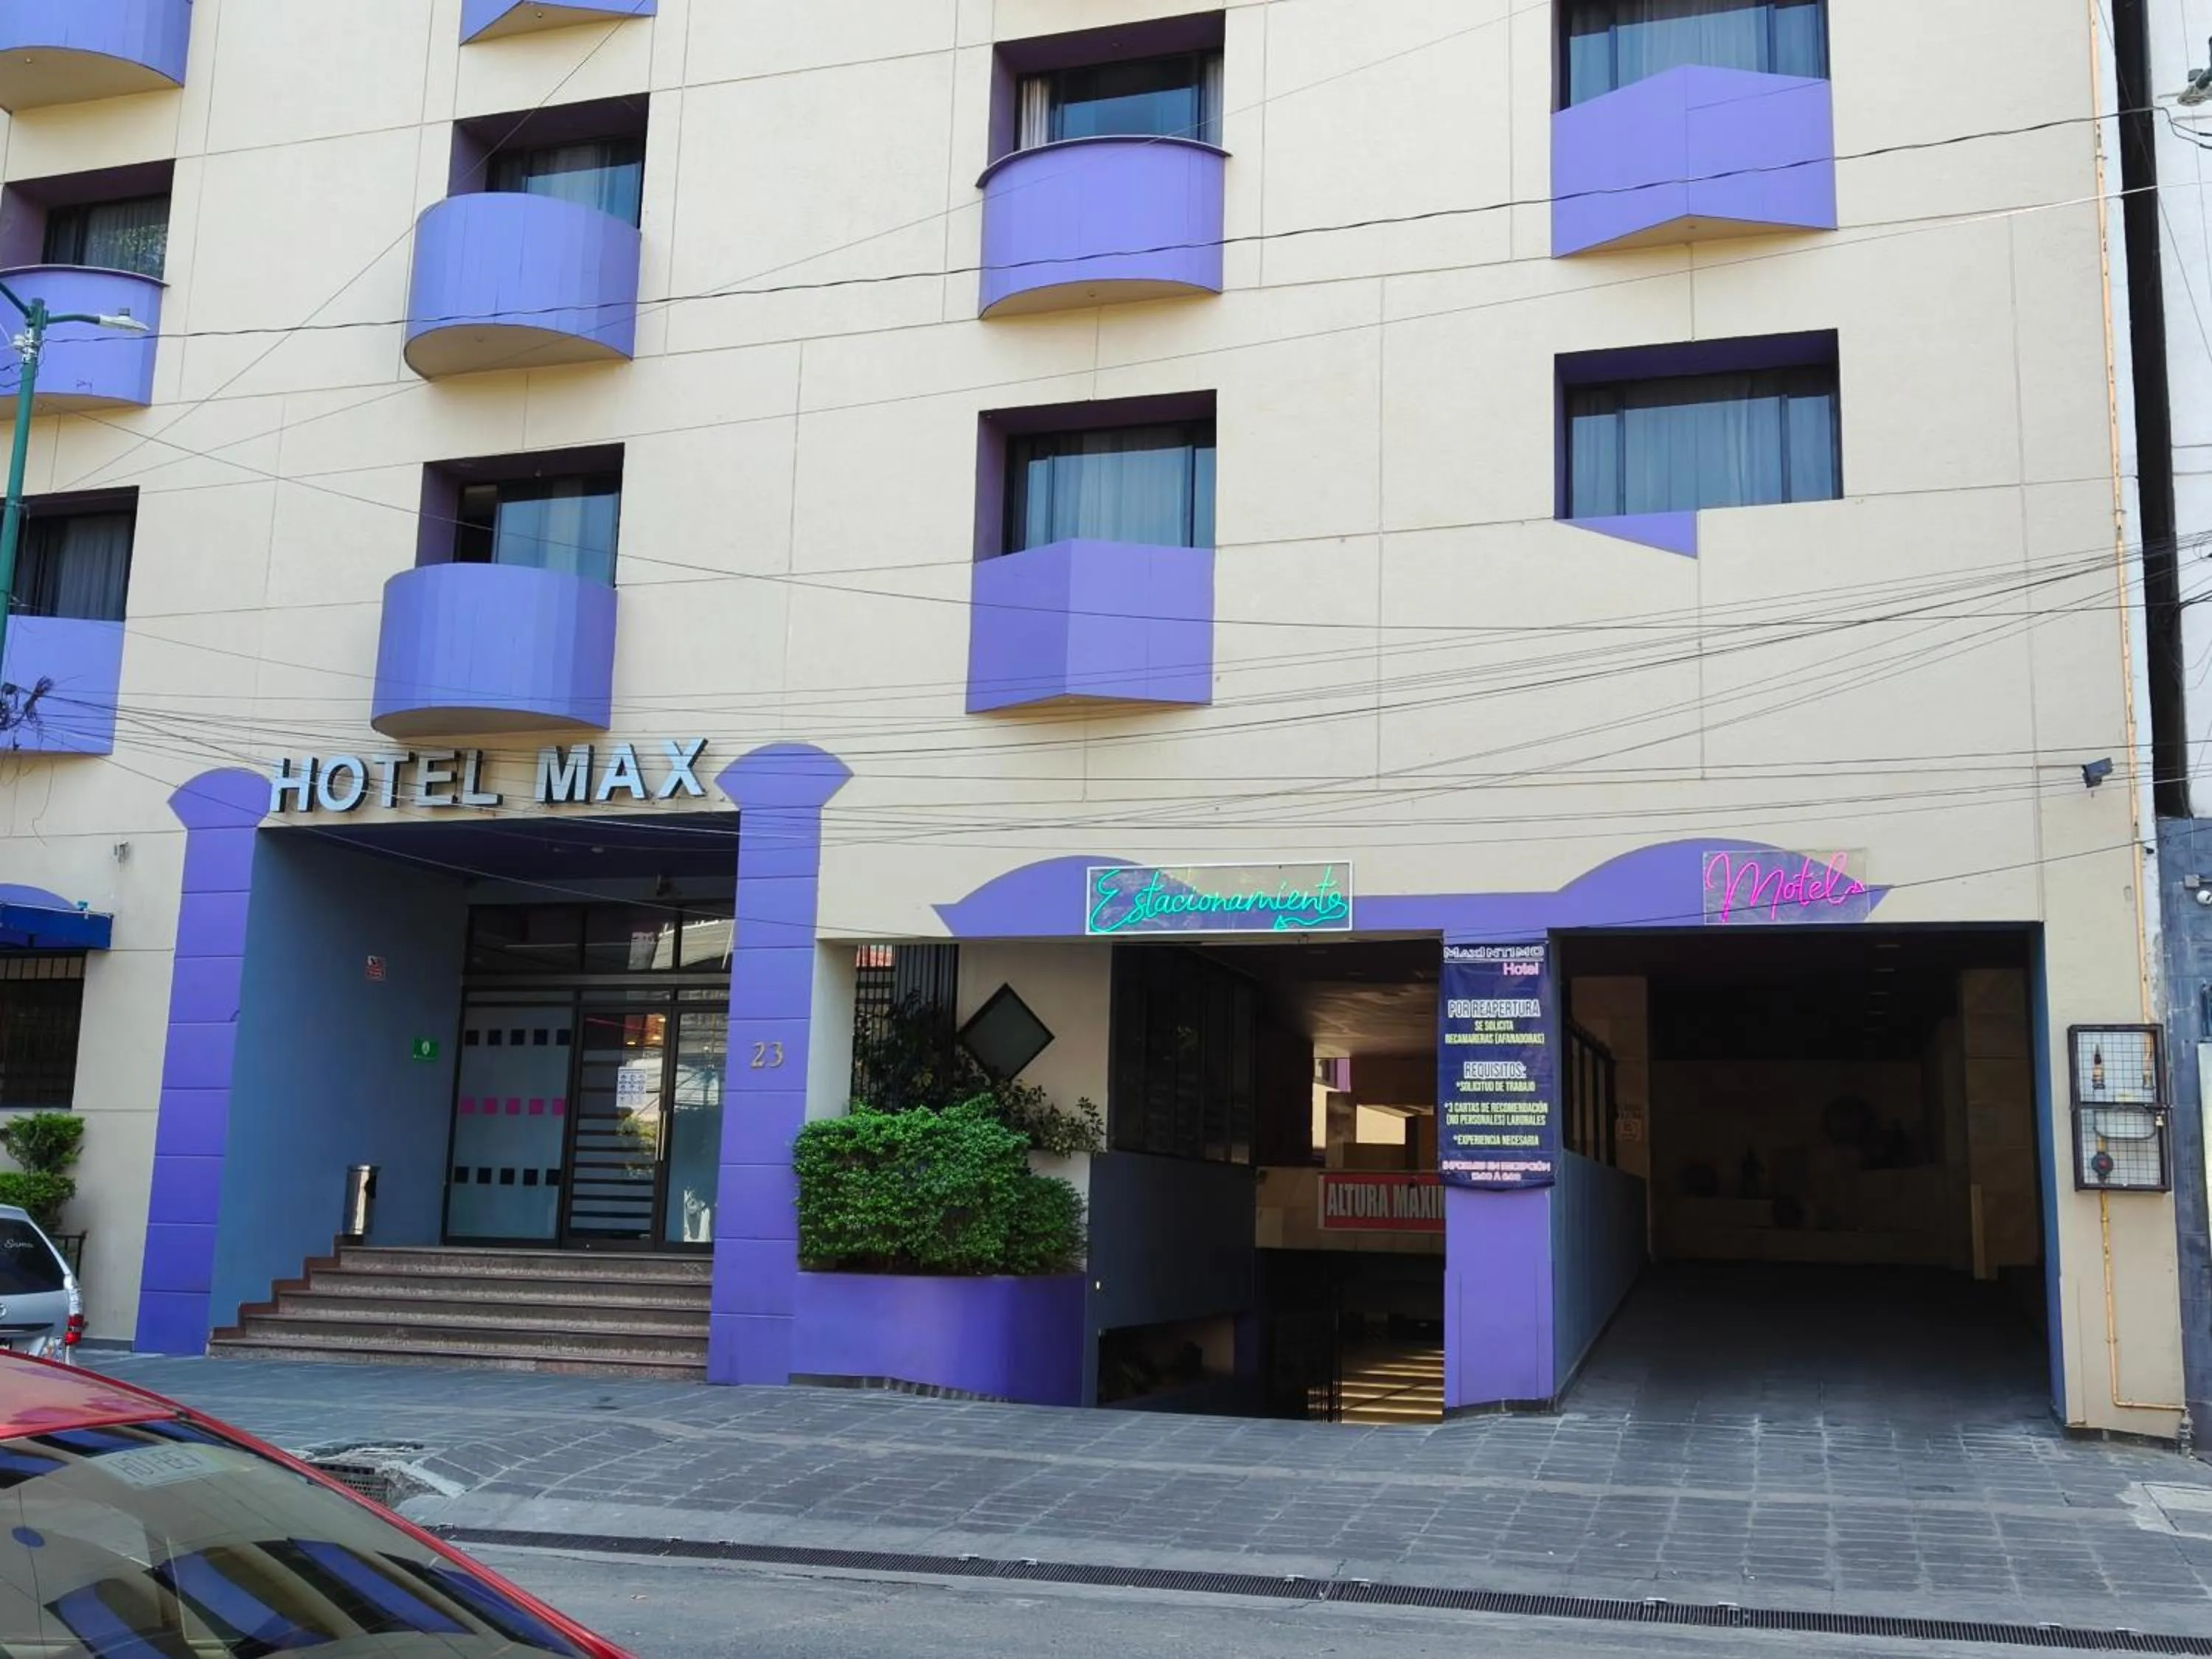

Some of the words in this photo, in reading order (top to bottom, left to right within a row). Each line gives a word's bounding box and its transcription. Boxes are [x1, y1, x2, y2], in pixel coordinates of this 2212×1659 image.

[270, 749, 503, 813] HOTEL
[534, 737, 708, 804] MAX
[1705, 849, 1847, 923] Motel
[1090, 865, 1346, 933] Estacionamiento
[1503, 962, 1540, 975] Hotel
[1447, 999, 1471, 1018] POR
[1471, 999, 1542, 1018] REAPERTURA
[1475, 1020, 1484, 1031] SE
[1484, 1020, 1514, 1030] SOLICITA
[750, 1041, 783, 1069] 23
[1464, 1061, 1527, 1079] REQUISITOS:
[1495, 1081, 1505, 1092] DE
[1327, 1183, 1389, 1218] ALTURA
